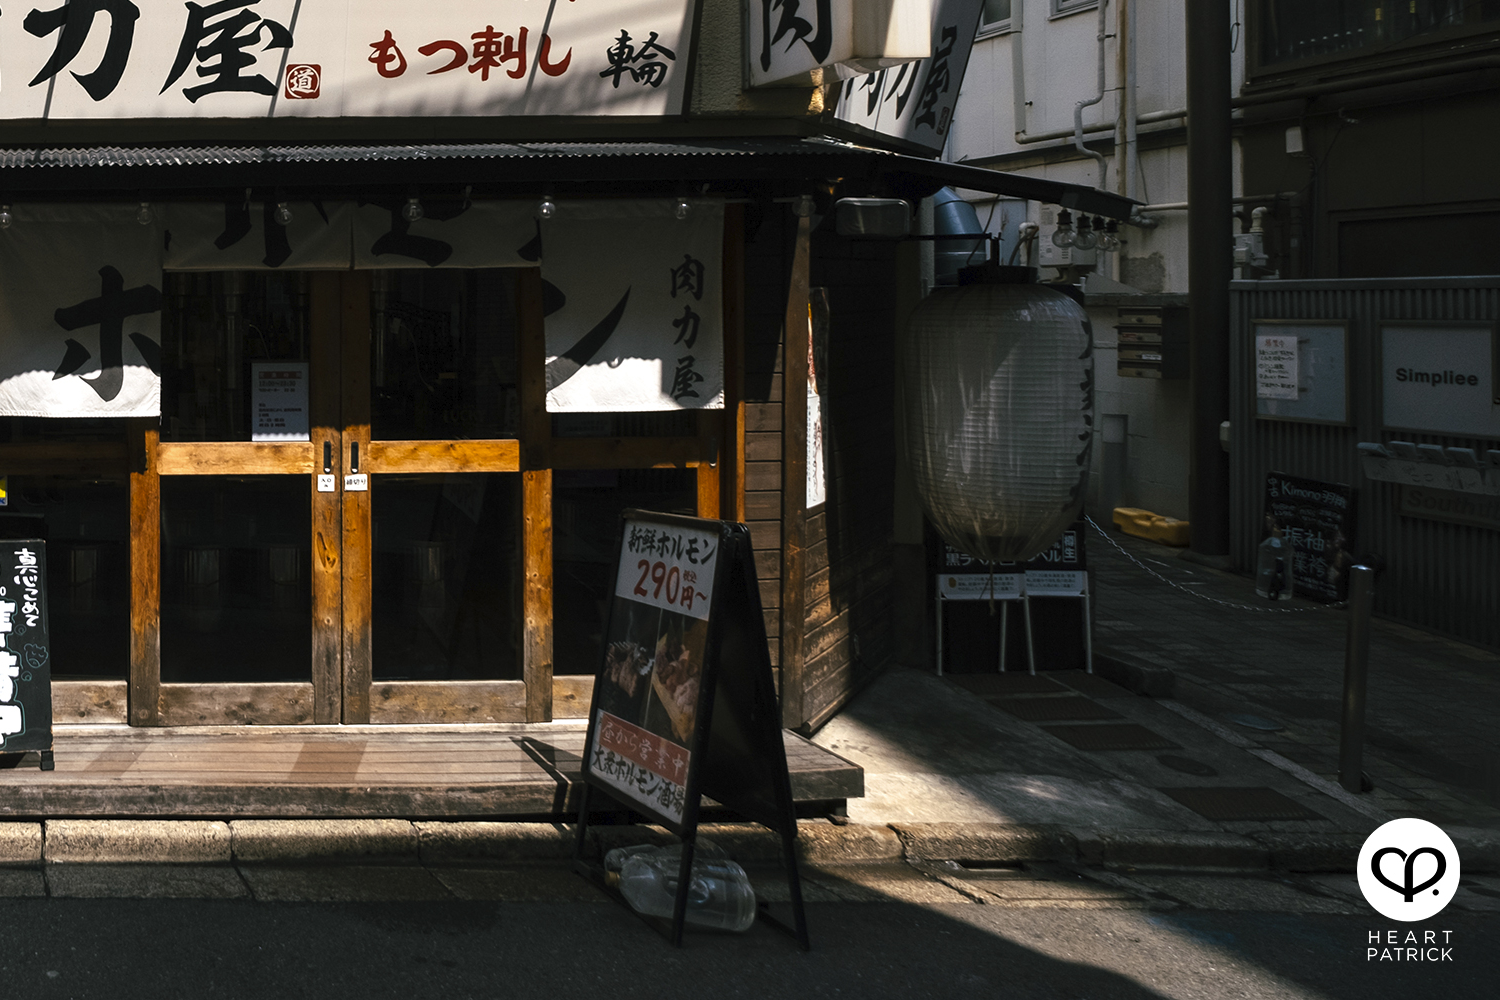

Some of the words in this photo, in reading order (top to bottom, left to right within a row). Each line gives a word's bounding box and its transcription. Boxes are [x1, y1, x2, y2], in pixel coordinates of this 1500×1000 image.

[367, 25, 573, 82] もつ刺し
[289, 68, 317, 96] 道
[669, 254, 706, 400] 肉力屋
[1395, 367, 1479, 387] Simpliee
[1281, 480, 1322, 501] Kimono
[627, 525, 717, 567] 新鮮ホルモン
[1281, 525, 1325, 552] 振袖
[13, 548, 40, 627] 真心こめて
[633, 559, 681, 605] 290
[601, 722, 686, 780] 昼から営業中
